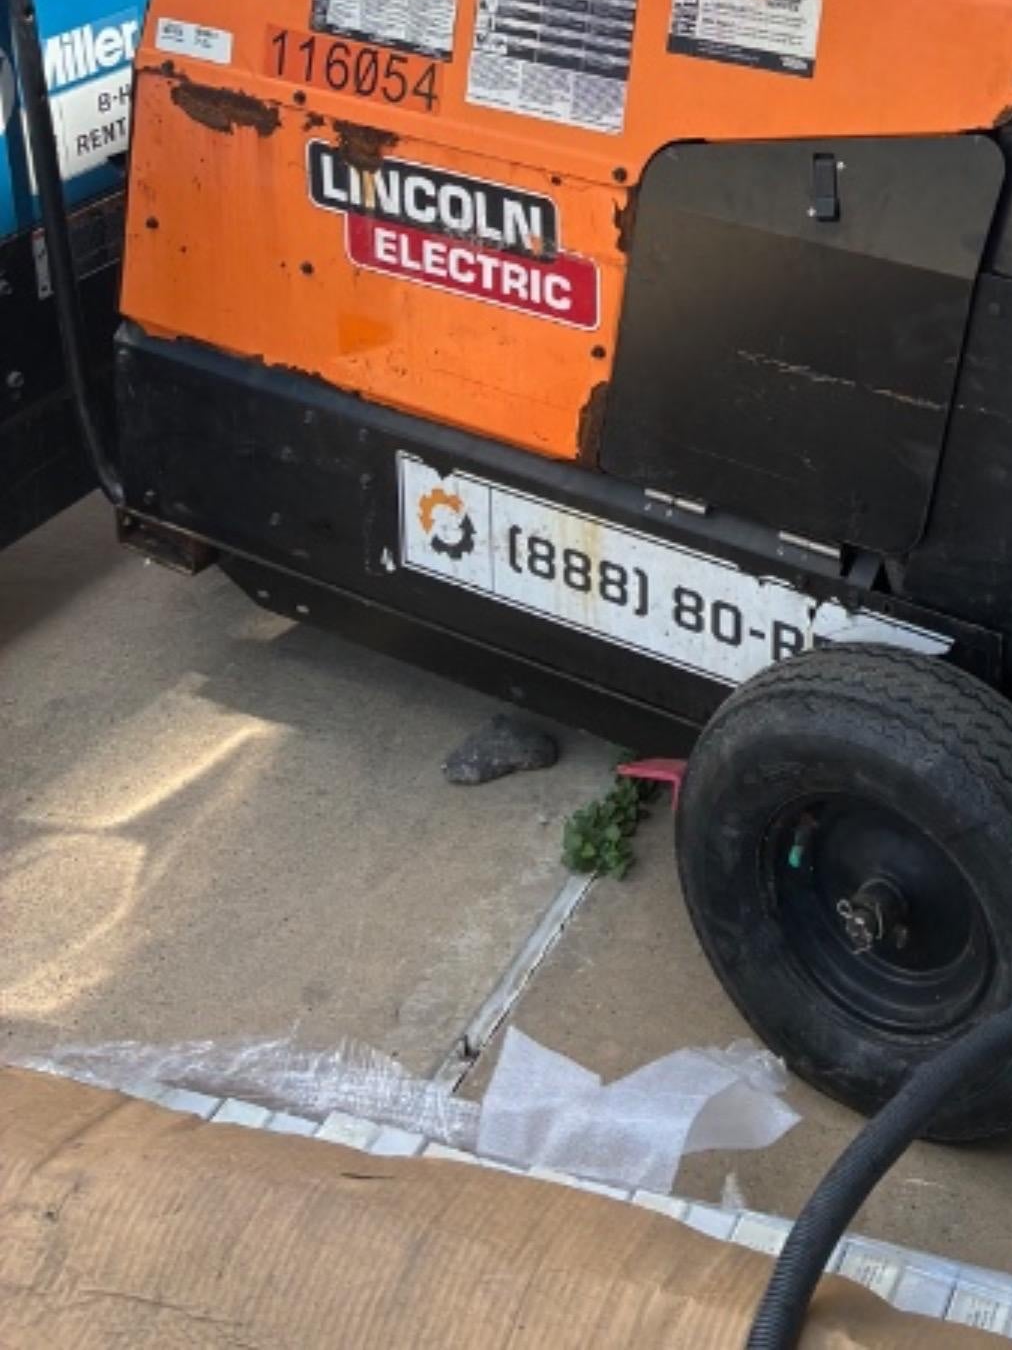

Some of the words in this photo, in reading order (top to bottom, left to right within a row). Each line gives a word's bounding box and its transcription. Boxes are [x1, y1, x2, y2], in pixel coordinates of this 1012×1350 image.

[272, 29, 439, 112] 116054
[320, 152, 545, 255] LINCOLN
[373, 227, 572, 311] ELECTRIC
[508, 524, 649, 618] (888)
